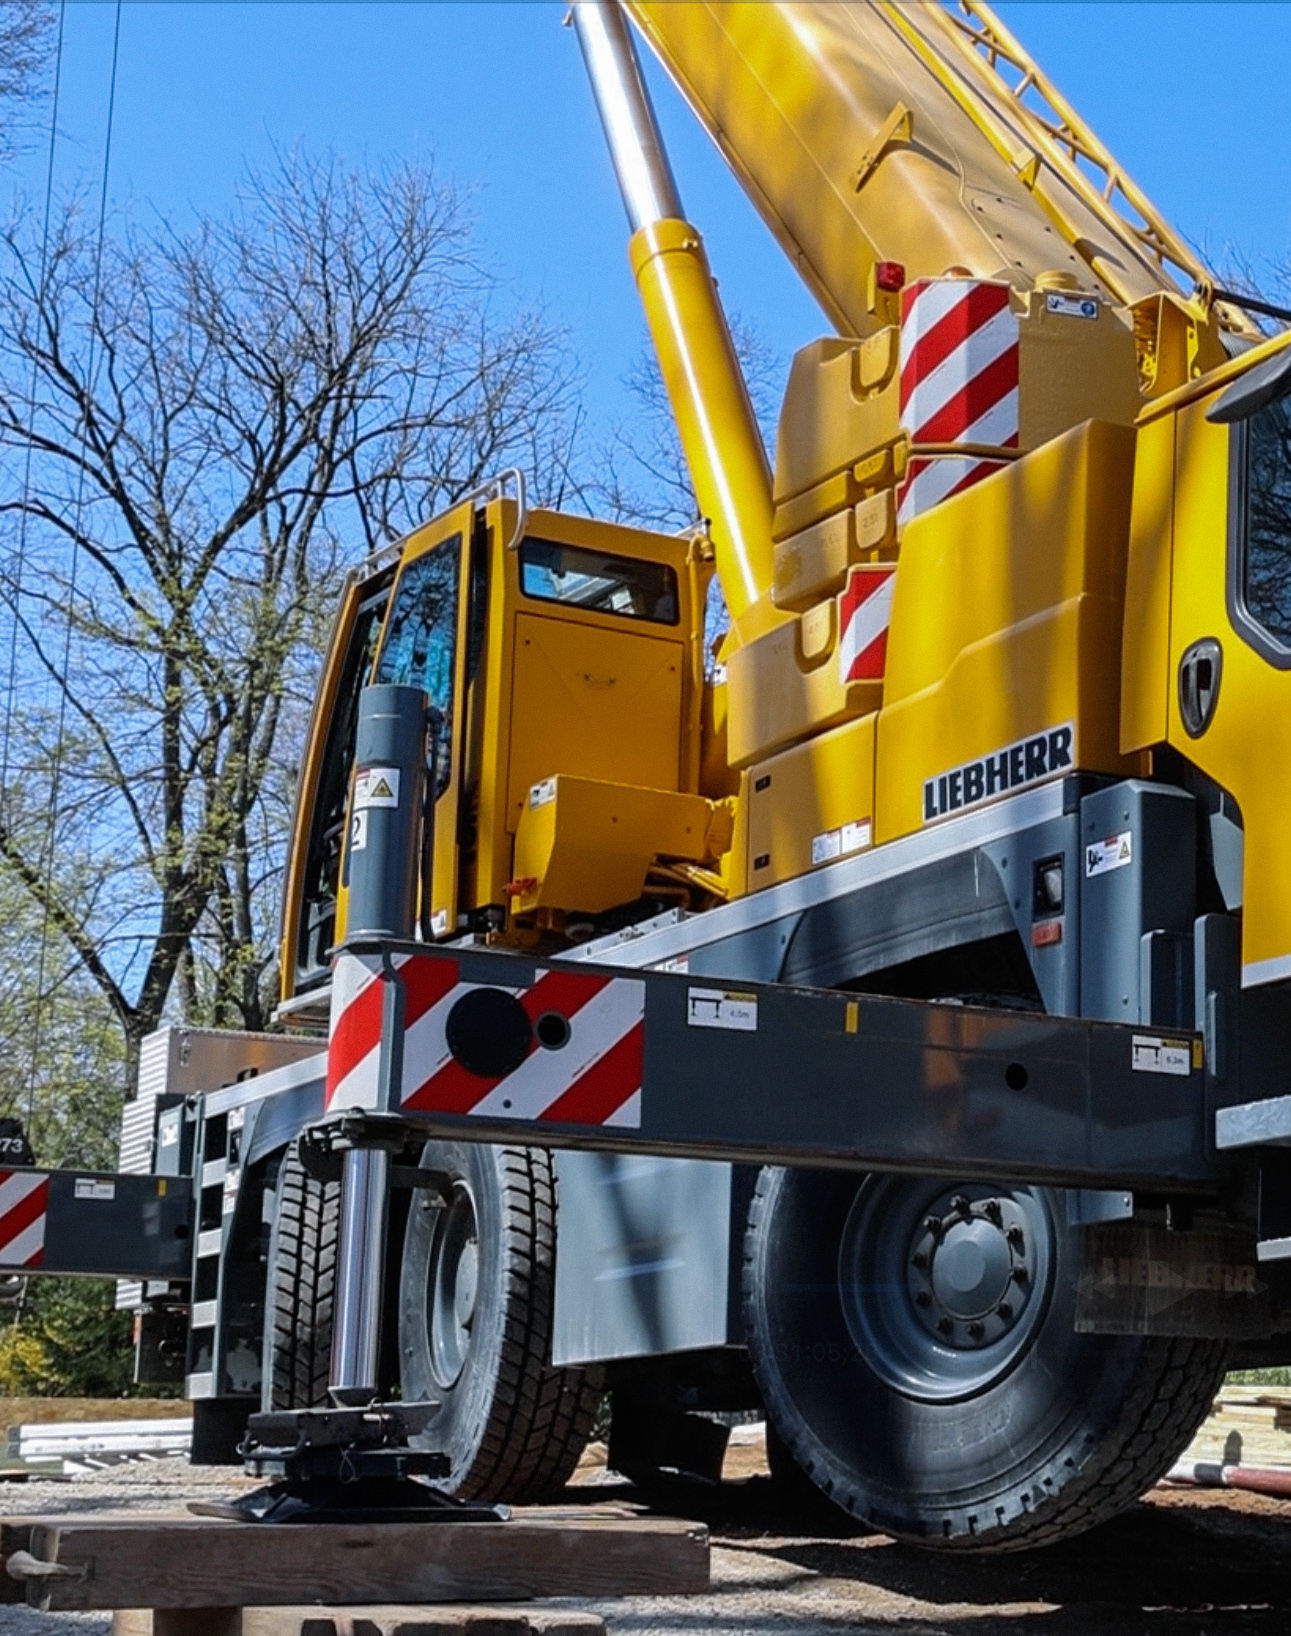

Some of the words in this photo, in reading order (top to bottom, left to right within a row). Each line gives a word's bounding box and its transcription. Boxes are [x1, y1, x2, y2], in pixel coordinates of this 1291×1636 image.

[925, 726, 1073, 820] LIEBHERR
[0, 1137, 23, 1154] 73
[1101, 1258, 1256, 1293] LIEBHERR
